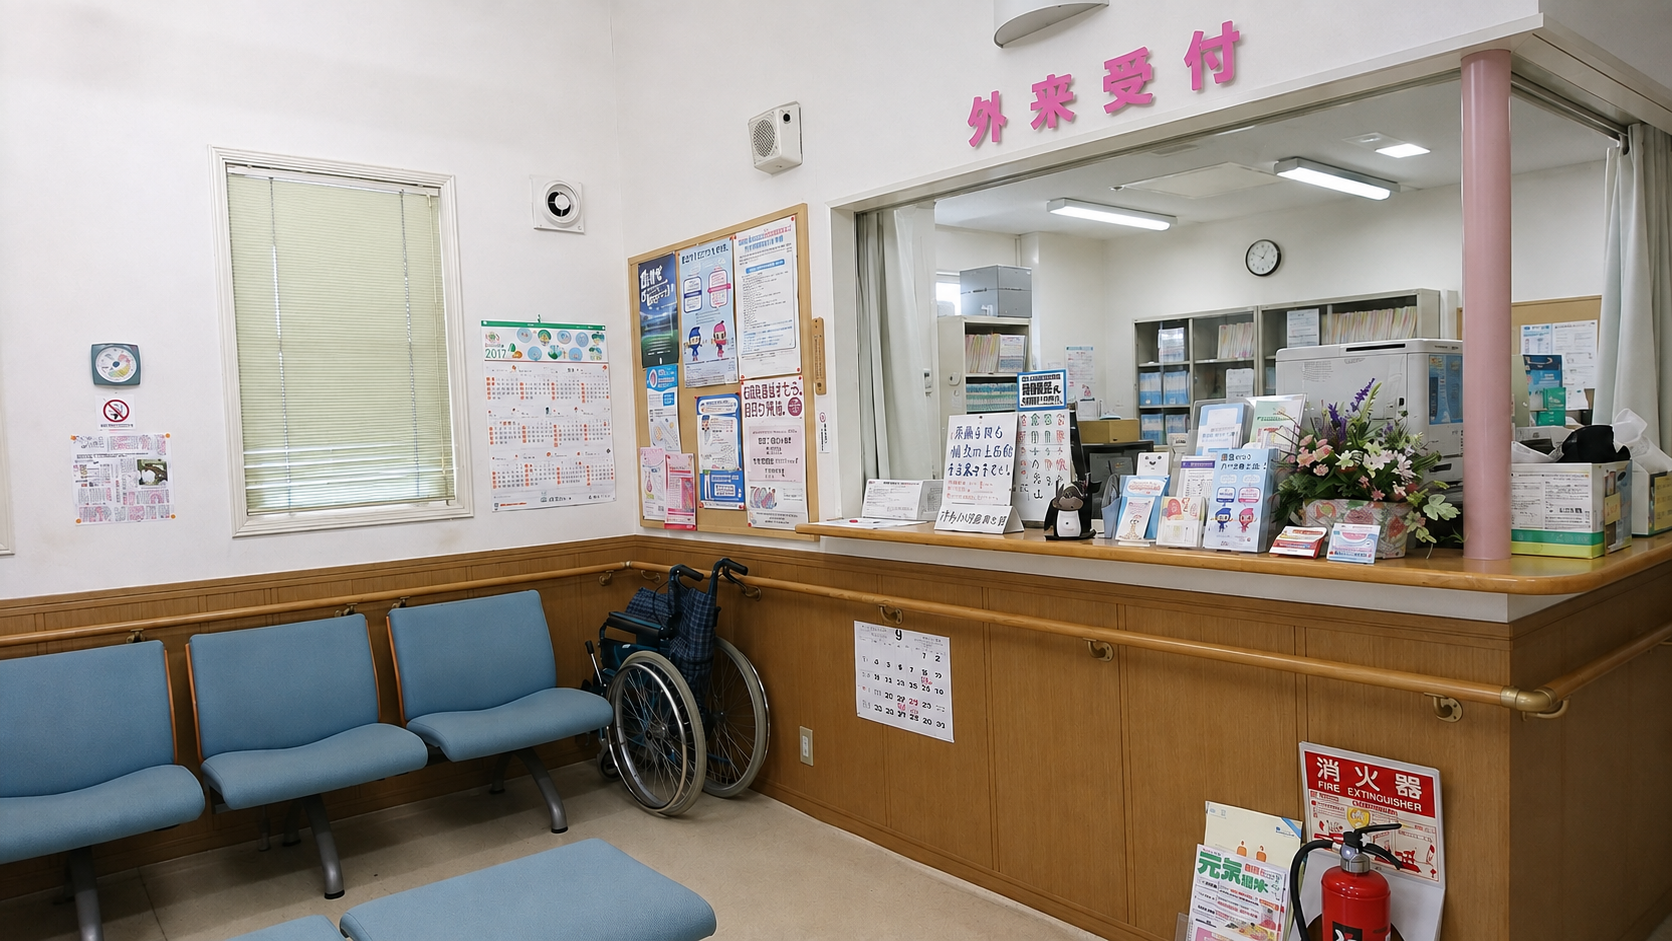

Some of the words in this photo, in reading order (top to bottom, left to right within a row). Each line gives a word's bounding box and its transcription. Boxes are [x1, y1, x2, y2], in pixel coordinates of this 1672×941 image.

[967, 20, 1240, 147] 外来受付
[485, 348, 506, 359] 2017
[1316, 756, 1422, 800] 消火器
[1318, 780, 1341, 793] FIRE
[1347, 787, 1422, 812] EXTINGUISHER
